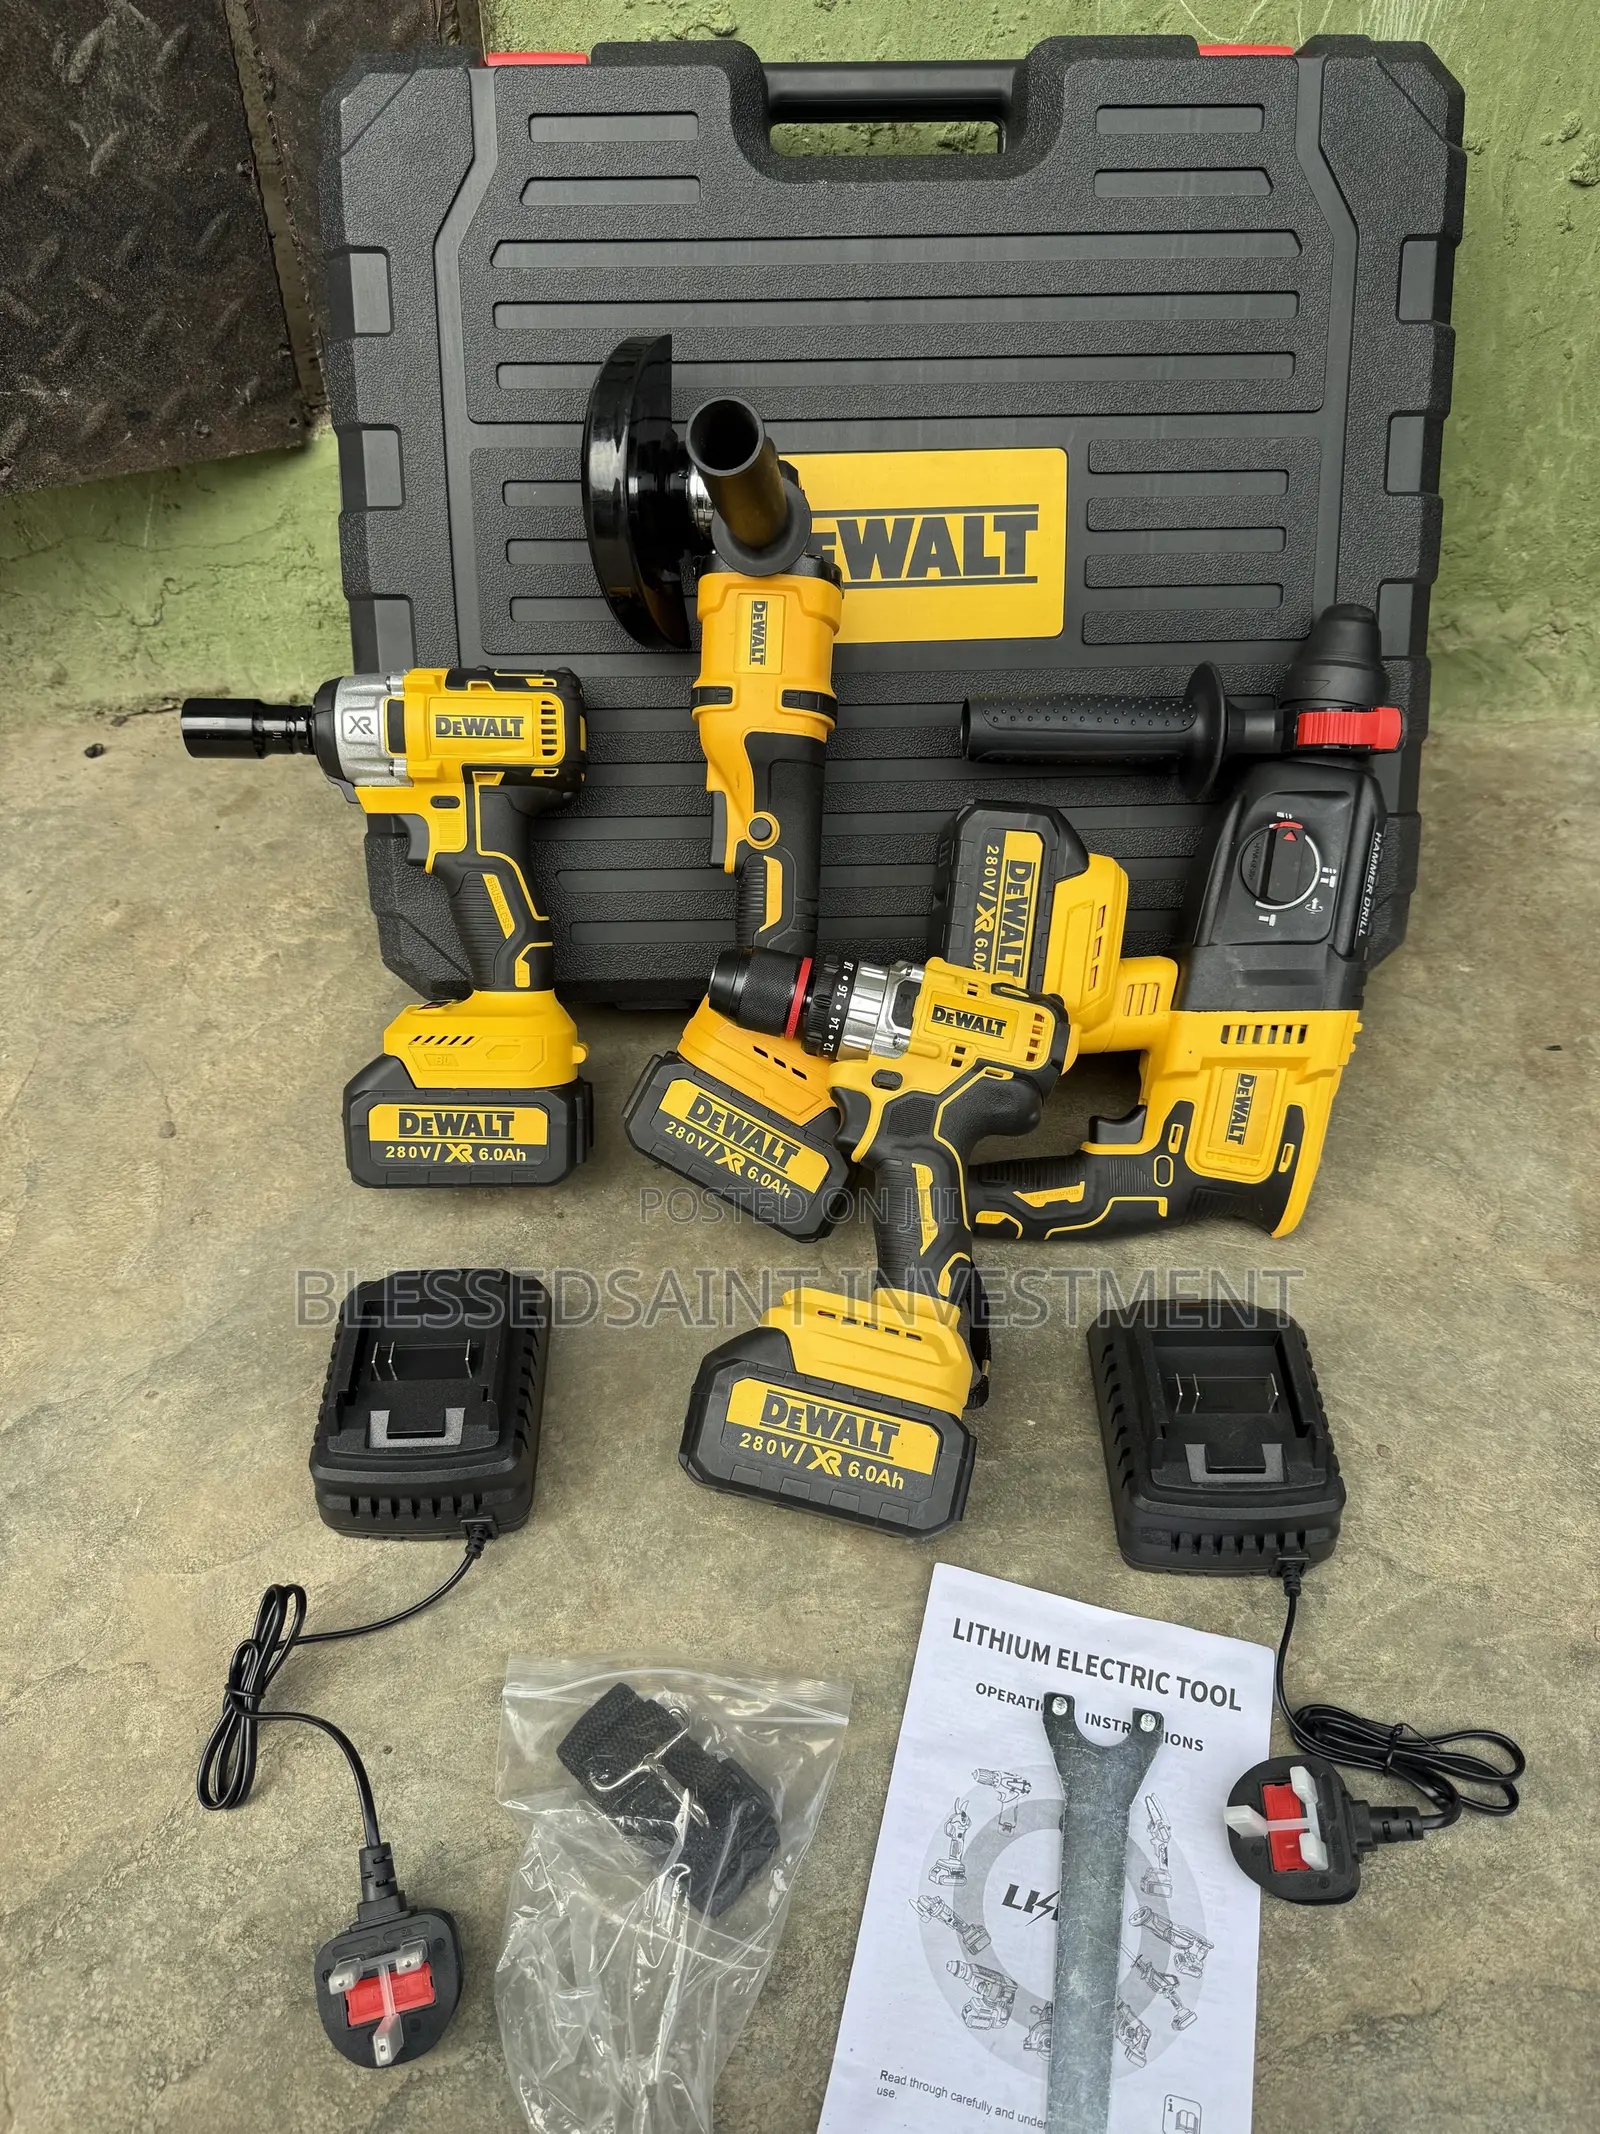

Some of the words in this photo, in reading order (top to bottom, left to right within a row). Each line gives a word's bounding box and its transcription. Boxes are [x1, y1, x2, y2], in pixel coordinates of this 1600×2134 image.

[806, 513, 1039, 581] EWALT
[751, 600, 767, 666] DEWALT
[348, 715, 375, 735] XR
[435, 716, 524, 738] DEWALT
[1365, 831, 1383, 895] HAMMER
[997, 860, 1033, 977] DEWALT
[1358, 897, 1371, 937] DRILL
[972, 937, 989, 973] 6.0A
[822, 1042, 834, 1052] 12
[829, 1017, 841, 1031] 14
[836, 984, 848, 999] 16
[843, 961, 854, 971] 18
[931, 1006, 1008, 1038] DEWALT
[398, 1112, 515, 1138] DEWALT
[687, 1094, 801, 1168] DEWALT
[1227, 1073, 1255, 1145] DEWALT
[478, 1148, 527, 1162] 6.0Ah
[747, 1165, 792, 1199] 6.0Ah
[760, 1393, 900, 1456] DEWALT
[847, 1460, 905, 1491] 6.0Ah
[952, 1616, 1051, 1666] LITHIUM
[1055, 1648, 1172, 1696] ELECTRIC
[1176, 1675, 1243, 1712] TOOL
[974, 1682, 1044, 1712] OPERATI
[1084, 1711, 1205, 1752] INSTRIONS
[876, 2085, 898, 2100] use.
[879, 2069, 908, 2086] Read
[909, 2077, 949, 2099] through
[950, 2091, 993, 2116] carefully
[994, 2106, 1016, 2121] and
[1017, 2113, 1048, 2131] under
